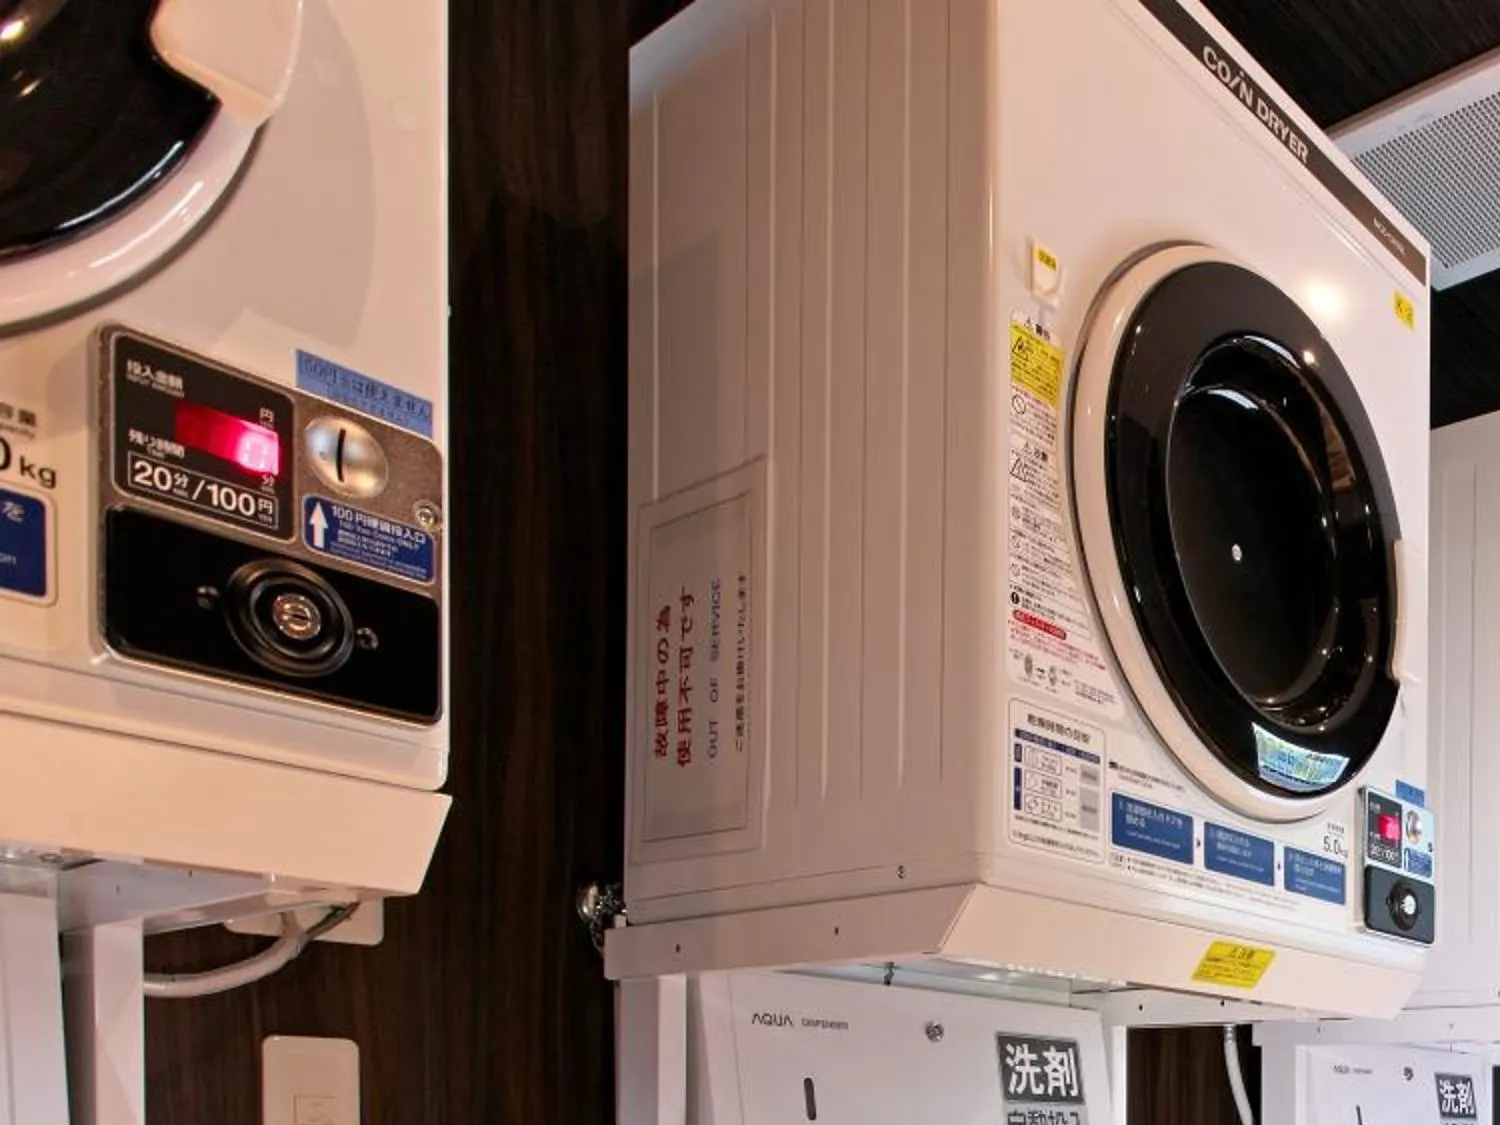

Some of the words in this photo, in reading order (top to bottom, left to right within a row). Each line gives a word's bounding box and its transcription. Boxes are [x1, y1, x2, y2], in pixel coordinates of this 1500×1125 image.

[1257, 100, 1309, 164] DRYER
[710, 578, 721, 663] SERVICE
[676, 584, 695, 768] 使用不可です
[709, 677, 720, 704] OF
[707, 719, 720, 760] OUT
[751, 1013, 794, 1028] AQUA
[1004, 1043, 1079, 1098] 洗剤
[1439, 1079, 1475, 1115] 洗剤
